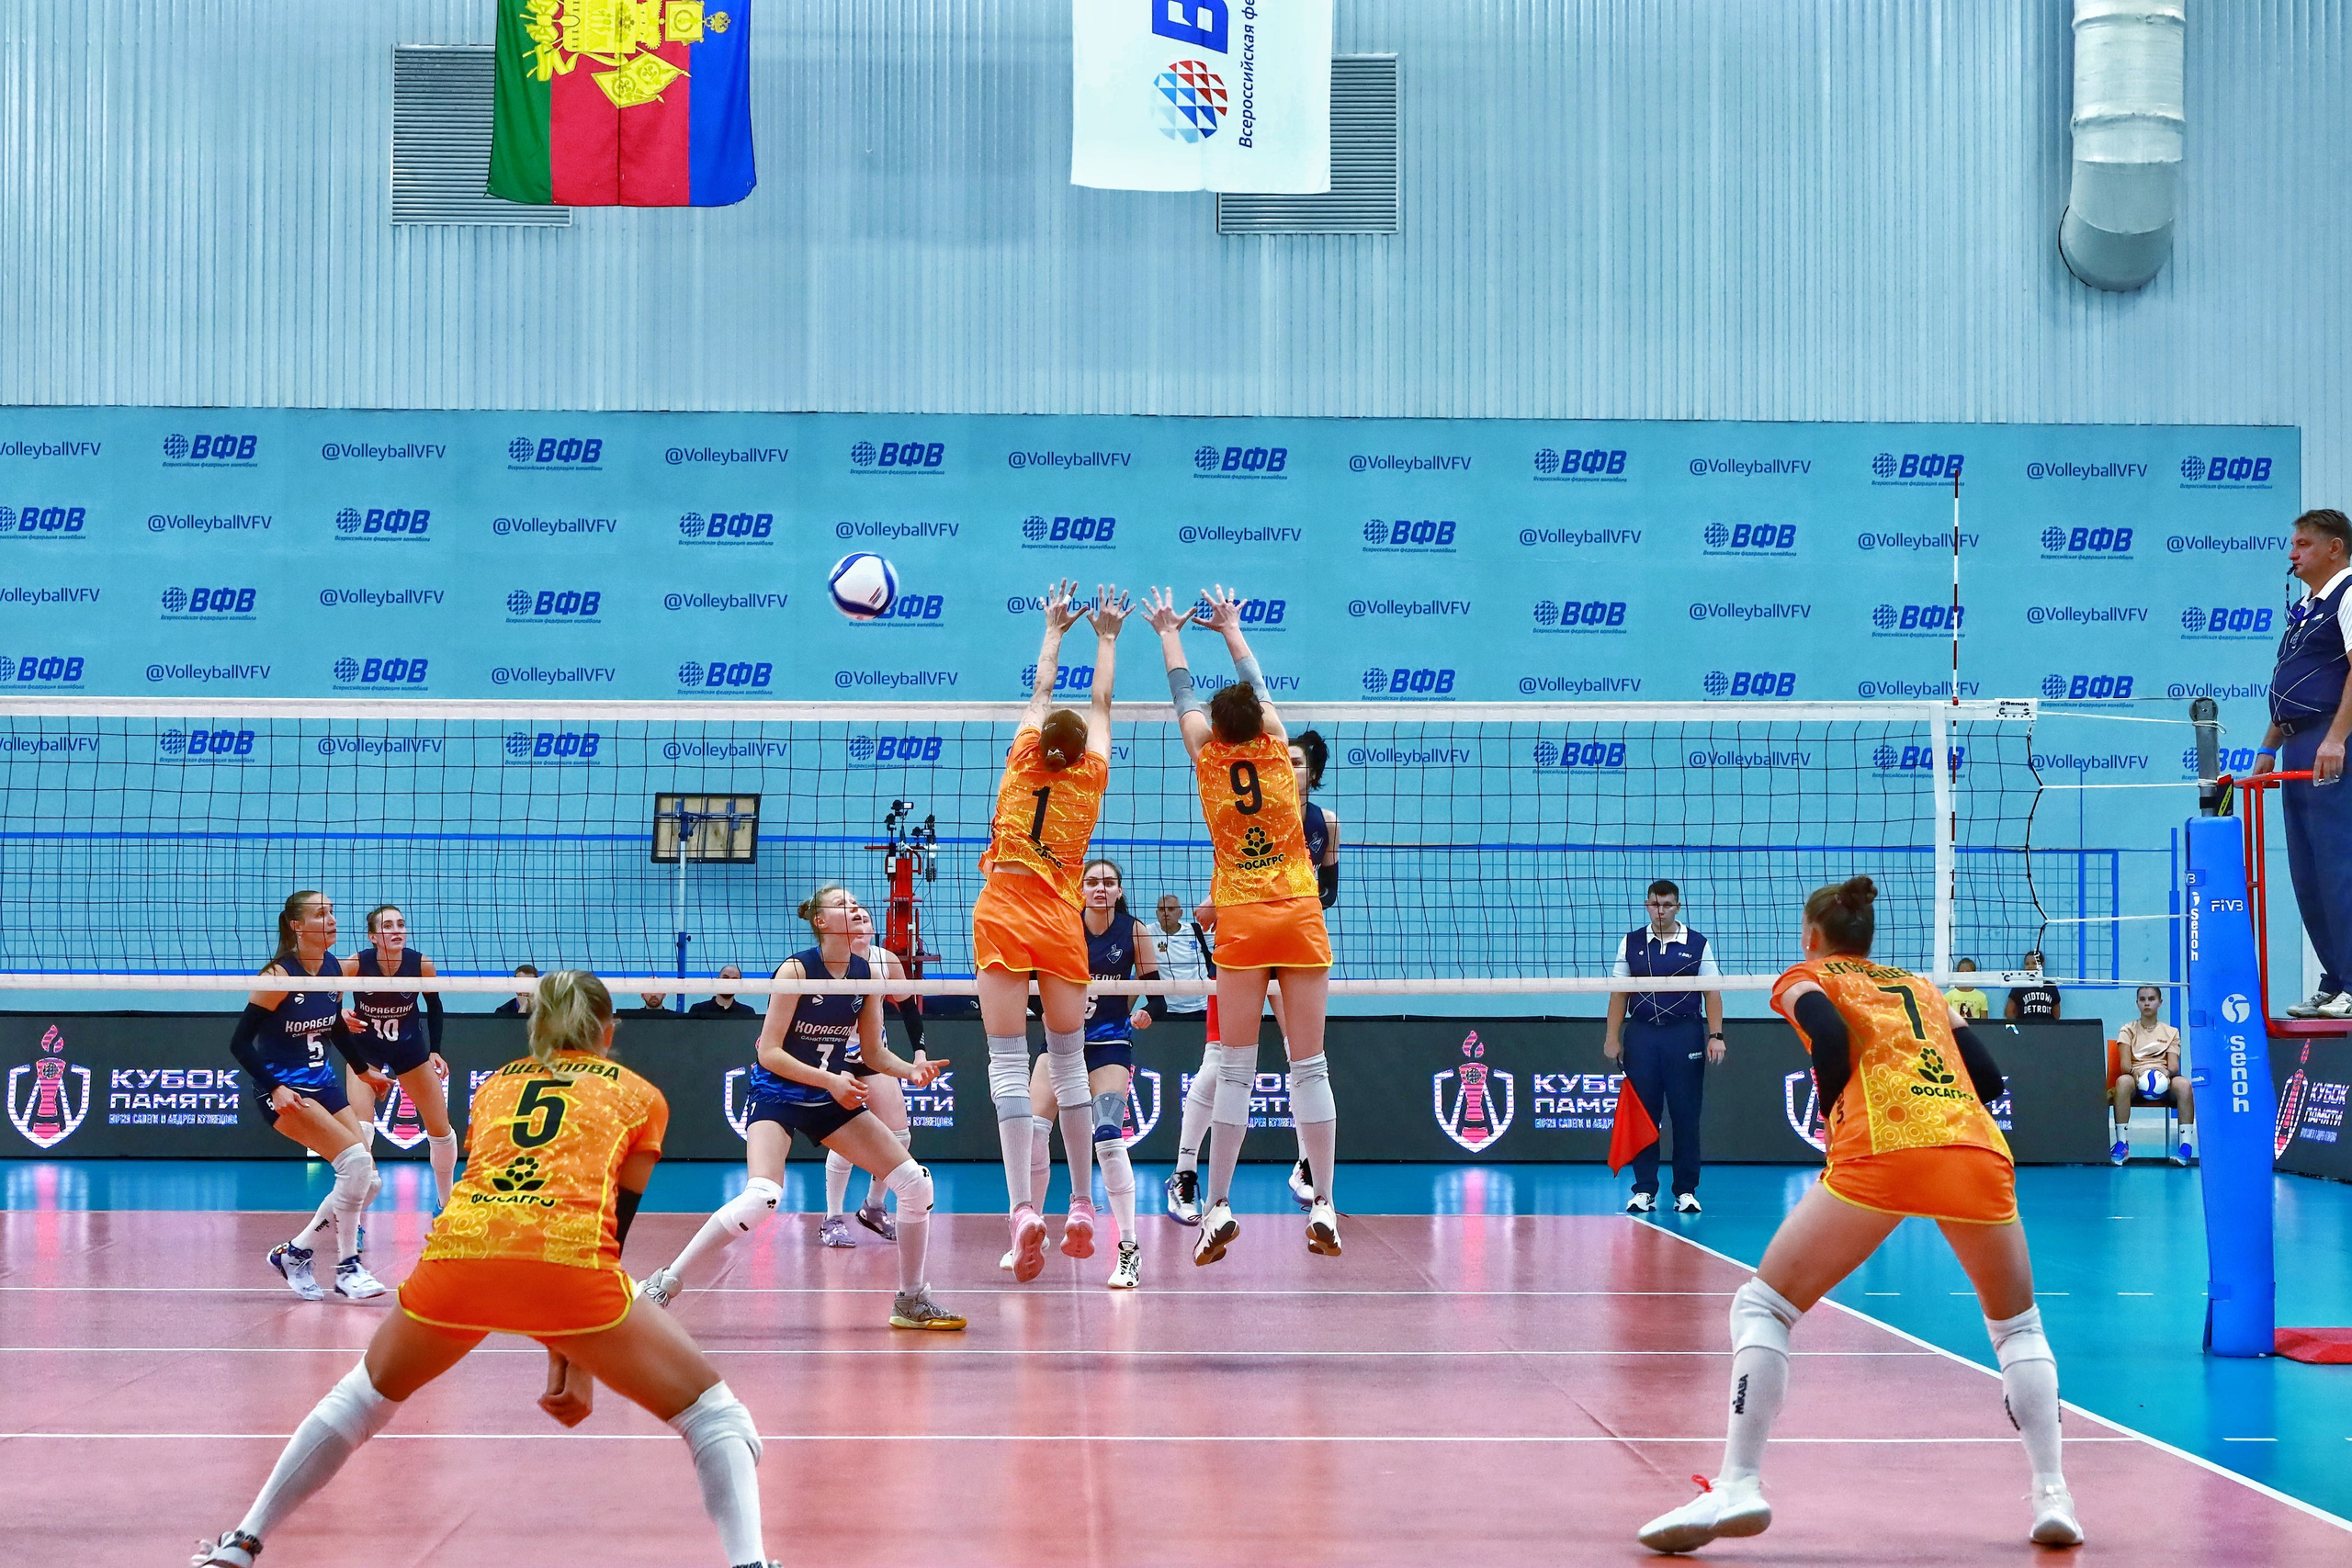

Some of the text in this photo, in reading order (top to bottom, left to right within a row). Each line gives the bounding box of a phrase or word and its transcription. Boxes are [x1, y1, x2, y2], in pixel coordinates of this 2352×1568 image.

[1239, 25, 1256, 149] Всероссийская
[190, 434, 257, 459] ВФВ
[322, 444, 446, 462] @VolleyballVFV
[537, 438, 603, 463] ВФВ
[665, 447, 788, 466] @VolleyballVFV
[878, 442, 944, 467] ВФВ
[1009, 451, 1131, 469] @VolleyballVFV
[1222, 446, 1287, 471] ВФВ
[1350, 455, 1471, 473] @VolleyballVFV
[1562, 449, 1627, 474] ВФВ
[1690, 458, 1811, 477] @VolleyballVFV
[1899, 454, 1964, 478] ВФВ
[2207, 457, 2272, 481] ВФВ
[2027, 462, 2147, 480] @VolleyballVFV
[18, 507, 85, 532] ВФВ
[148, 514, 272, 533] @VolleyballVFV
[363, 509, 430, 534] ВФВ
[493, 518, 616, 536] @VolleyballVFV
[707, 513, 773, 538] ВФВ
[836, 522, 959, 540] @VolleyballVFV
[1050, 517, 1115, 541] ВФВ
[1180, 526, 1301, 545] @VolleyballVFV
[1391, 520, 1456, 545] ВФВ
[1520, 529, 1641, 547] @VolleyballVFV
[1731, 524, 1796, 548] ВФВ
[1859, 533, 1979, 550] @VolleyballVFV
[2069, 527, 2133, 552] ВФВ
[2167, 536, 2287, 553] @VolleyballVFV
[189, 588, 256, 612] ВФВ
[320, 589, 444, 607] @VolleyballVFV
[534, 591, 601, 615] ВФВ
[664, 593, 787, 612] @VolleyballVFV
[1349, 600, 1470, 618] @VolleyballVFV
[1561, 602, 1626, 626] ВФВ
[1690, 604, 1811, 622] @VolleyballVFV
[1899, 605, 1964, 629] ВФВ
[2028, 607, 2148, 626] @VolleyballVFV
[2208, 607, 2273, 632] ВФВ
[17, 656, 84, 681] ВФВ
[146, 664, 270, 682] @VolleyballVFV
[361, 658, 428, 682] ВФВ
[492, 667, 615, 685] @VolleyballVFV
[707, 661, 773, 686] ВФВ
[835, 671, 957, 689] @VolleyballVFV
[1390, 670, 1455, 694] ВФВ
[1520, 677, 1641, 695] @VolleyballVFV
[1731, 672, 1796, 696] ВФВ
[1859, 681, 1979, 698] @VolleyballVFV
[2069, 675, 2133, 699] ВФВ
[2167, 683, 2272, 702] @VolleyballV
[188, 729, 254, 755] ВФВ
[318, 738, 442, 756] @VolleyballVFV
[533, 733, 599, 758] ВФВ
[663, 742, 786, 760] @VolleyballVFV
[878, 736, 943, 761] ВФВ
[1348, 748, 1470, 766] @VolleyballVFV
[1560, 742, 1625, 767] ВФВ
[1689, 750, 1811, 768] @VolleyballVFV
[2030, 754, 2148, 772] @VolleyballVFV
[1229, 761, 1262, 816] 9
[1032, 786, 1050, 845] 1
[360, 1001, 413, 1014] КОРАБЕЛКА
[1877, 986, 1927, 1040] 7
[2024, 1005, 2052, 1015] DETROIT
[371, 1019, 399, 1042] 10
[795, 1021, 854, 1036] КОРАБЕЛК
[307, 1033, 324, 1067] 5
[817, 1043, 834, 1071] 7
[111, 1069, 240, 1089] КУБОК
[1534, 1074, 1625, 1094] КУБО
[2230, 1035, 2250, 1112] Senoh
[109, 1093, 240, 1110] ПАМЯТИ
[2309, 1082, 2349, 1105] КУБОК
[510, 1078, 576, 1148] 5
[1534, 1098, 1618, 1113] ПАМЯ
[2303, 1107, 2344, 1126] ПАМЯТИ
